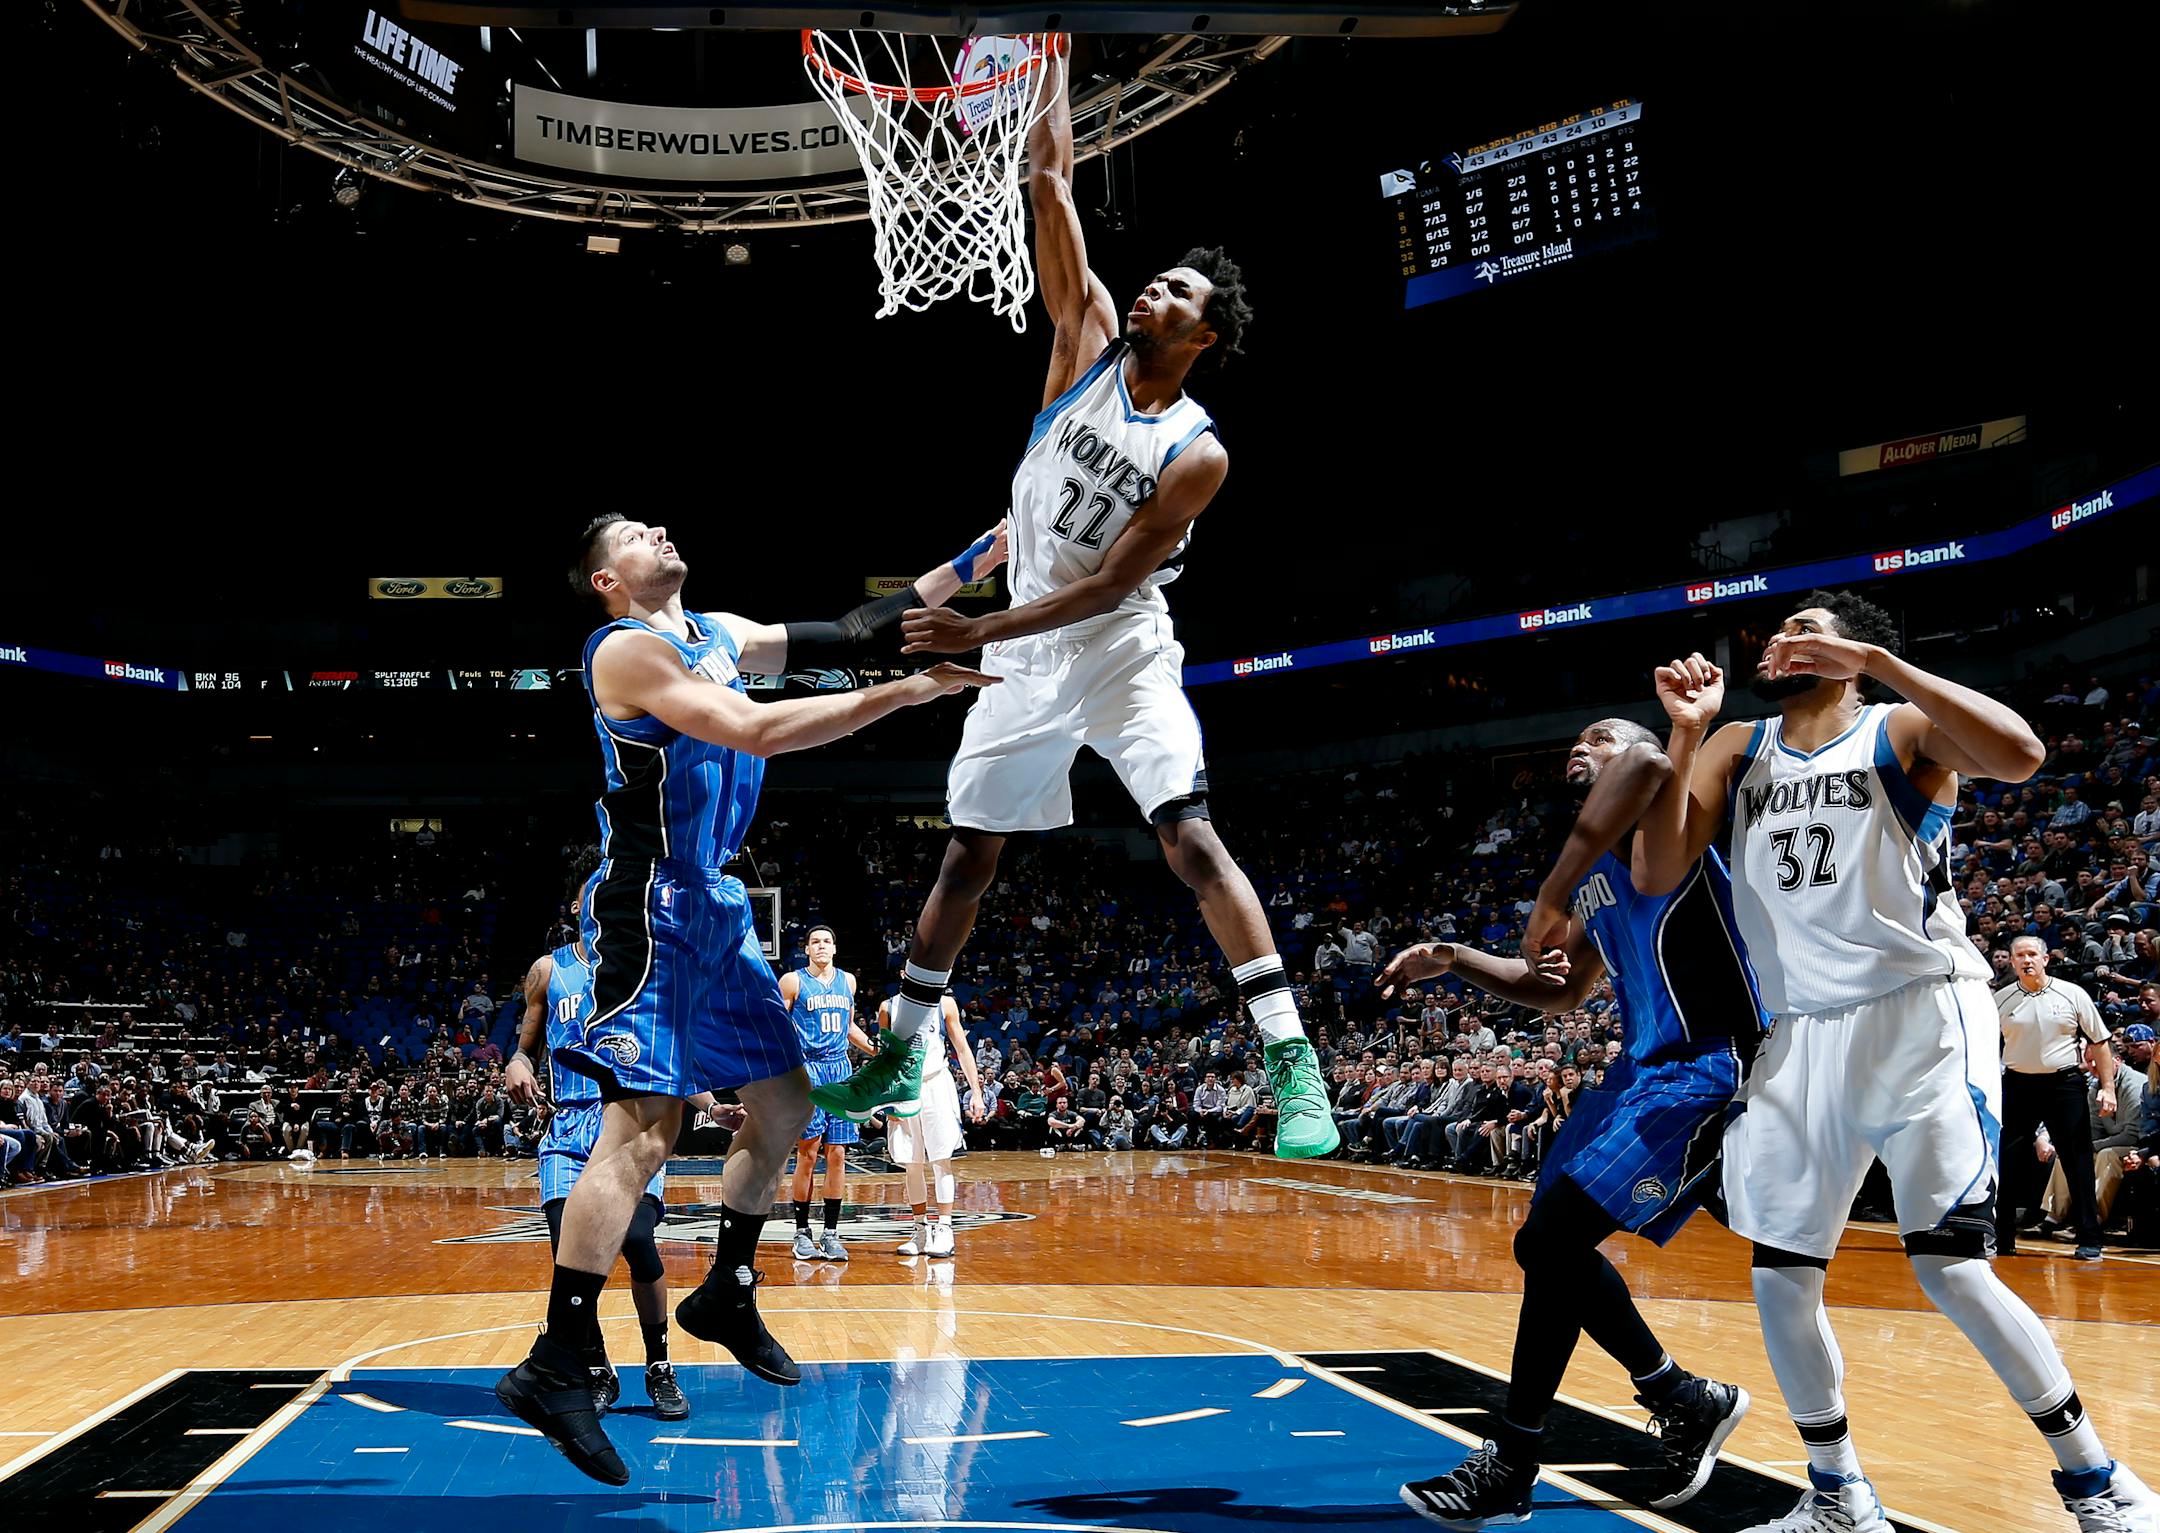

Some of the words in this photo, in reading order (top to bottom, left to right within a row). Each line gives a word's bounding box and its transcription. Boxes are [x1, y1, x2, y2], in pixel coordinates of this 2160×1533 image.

[363, 9, 409, 64] LIFE
[408, 35, 459, 95] TIME
[354, 45, 366, 60] THE
[366, 53, 394, 75] HEALTHY
[393, 69, 407, 82] WAY
[406, 78, 416, 87] OF
[415, 83, 428, 97] LIFE
[428, 91, 457, 112] COMPANY
[1561, 114, 1581, 126] AST
[1590, 107, 1605, 116] TO
[1612, 98, 1631, 110] STL
[1470, 156, 1485, 167] 43
[1494, 148, 1509, 160] 44
[1518, 141, 1533, 152] 70
[1541, 133, 1557, 144] 43
[1566, 125, 1582, 137] 24
[1591, 118, 1606, 130] 10
[1619, 111, 1627, 121] 3
[1423, 201, 1441, 214] 3/9
[1466, 188, 1483, 200] 1/6
[1507, 175, 1526, 187] 2/3
[1547, 166, 1555, 175] 0
[1567, 160, 1575, 169] 0
[1587, 154, 1595, 163] 3
[1606, 148, 1614, 158] 2
[1625, 142, 1633, 152] 9
[1424, 214, 1447, 227] 7/13
[1466, 202, 1484, 215] 6/7
[1509, 190, 1528, 202] 2/4
[1550, 181, 1557, 190] 2
[1569, 175, 1577, 184] 6
[1588, 169, 1596, 178] 6
[1607, 164, 1615, 173] 2
[1623, 156, 1639, 168] 22
[1399, 238, 1412, 249] 22
[1426, 227, 1450, 241] 6/15
[1470, 216, 1486, 228] 1/3
[1511, 203, 1530, 215] 4/6
[1551, 195, 1559, 204] 0
[1570, 189, 1578, 198] 5
[1590, 183, 1598, 192] 2
[1610, 178, 1616, 187] 1
[1626, 171, 1639, 182] 17
[1400, 252, 1414, 262] 32
[1428, 241, 1451, 255] 7/16
[1471, 230, 1488, 242] 1/2
[1512, 217, 1531, 230] 6/7
[1554, 210, 1560, 218] 1
[1572, 203, 1580, 213] 5
[1592, 198, 1600, 207] 7
[1610, 193, 1618, 202] 3
[1628, 186, 1642, 197] 21
[1430, 256, 1448, 268] 2/3
[1471, 244, 1490, 256] 0/0
[1514, 232, 1533, 244] 0/0
[1555, 224, 1562, 232] 1
[1574, 218, 1582, 227] 0
[1594, 212, 1602, 220] 4
[1613, 207, 1621, 216] 2
[1632, 201, 1640, 210] 4
[1500, 251, 1540, 270] Treasure
[1542, 237, 1572, 259] Island
[1051, 416, 1157, 508] WOLVES
[1048, 477, 1116, 550] 22
[2051, 490, 2114, 530] usbank
[1873, 542, 1965, 573] usbank
[387, 582, 418, 594] Ford
[453, 582, 484, 594] Ford
[1687, 574, 1768, 603] usbank
[1520, 603, 1592, 629] usbank
[1370, 629, 1435, 653] usbank
[105, 663, 165, 683] usbank
[195, 673, 217, 681] BKN
[225, 673, 239, 681] 96
[374, 671, 398, 679] SPLIT
[399, 671, 431, 679] RAFFLE
[1233, 653, 1293, 675] usbank
[195, 681, 216, 689] MIA
[221, 681, 241, 689] 104
[868, 679, 874, 687] 3
[1740, 769, 1872, 831] WOLVES
[1769, 823, 1838, 892] 32
[807, 994, 850, 1011] ORLANDO
[821, 1012, 841, 1032] 00
